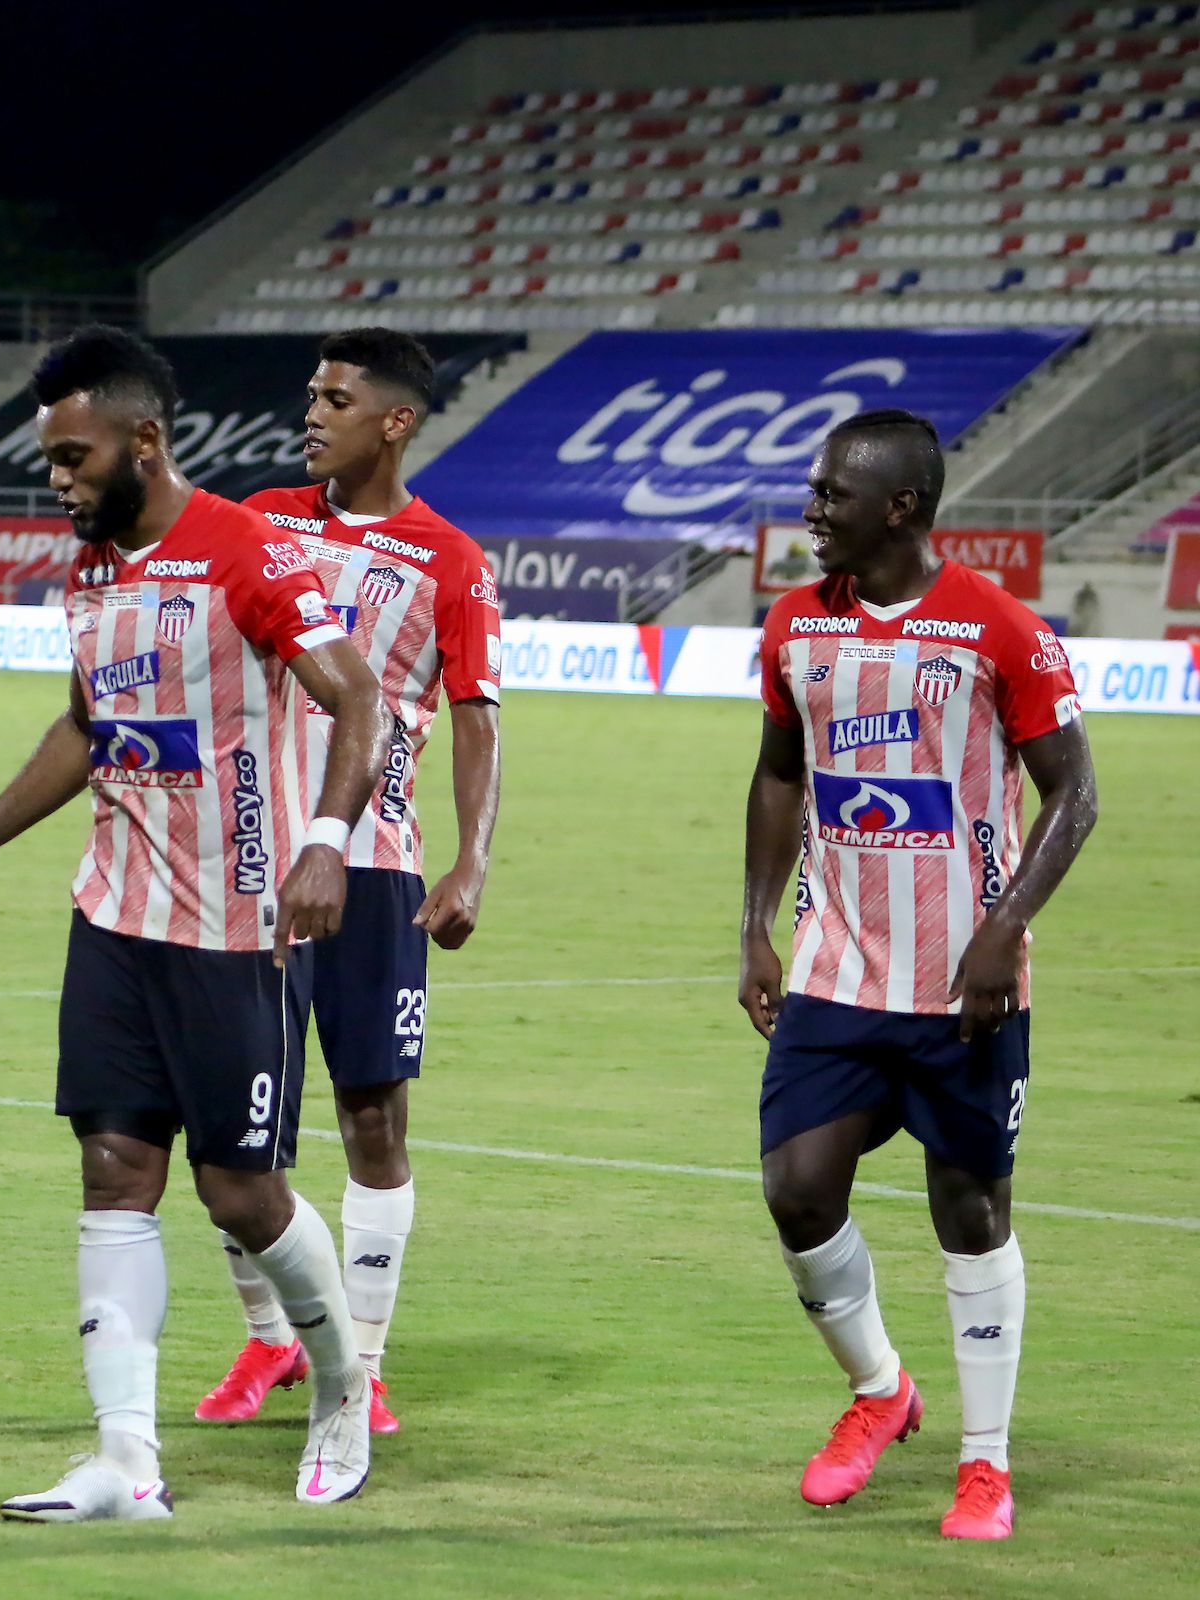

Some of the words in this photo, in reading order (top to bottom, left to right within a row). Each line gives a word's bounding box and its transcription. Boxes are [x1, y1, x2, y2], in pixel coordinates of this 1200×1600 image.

[369, 575, 396, 590] JUNIOR
[95, 654, 155, 697] AGUILA
[562, 642, 616, 681] con
[922, 671, 953, 682] JUNIOR
[1103, 663, 1168, 701] con
[832, 711, 913, 752] AGUILA
[821, 825, 951, 849] OLIMPICA
[394, 988, 425, 1035] 23
[249, 1072, 272, 1124] 9
[1007, 1078, 1027, 1130] 2
